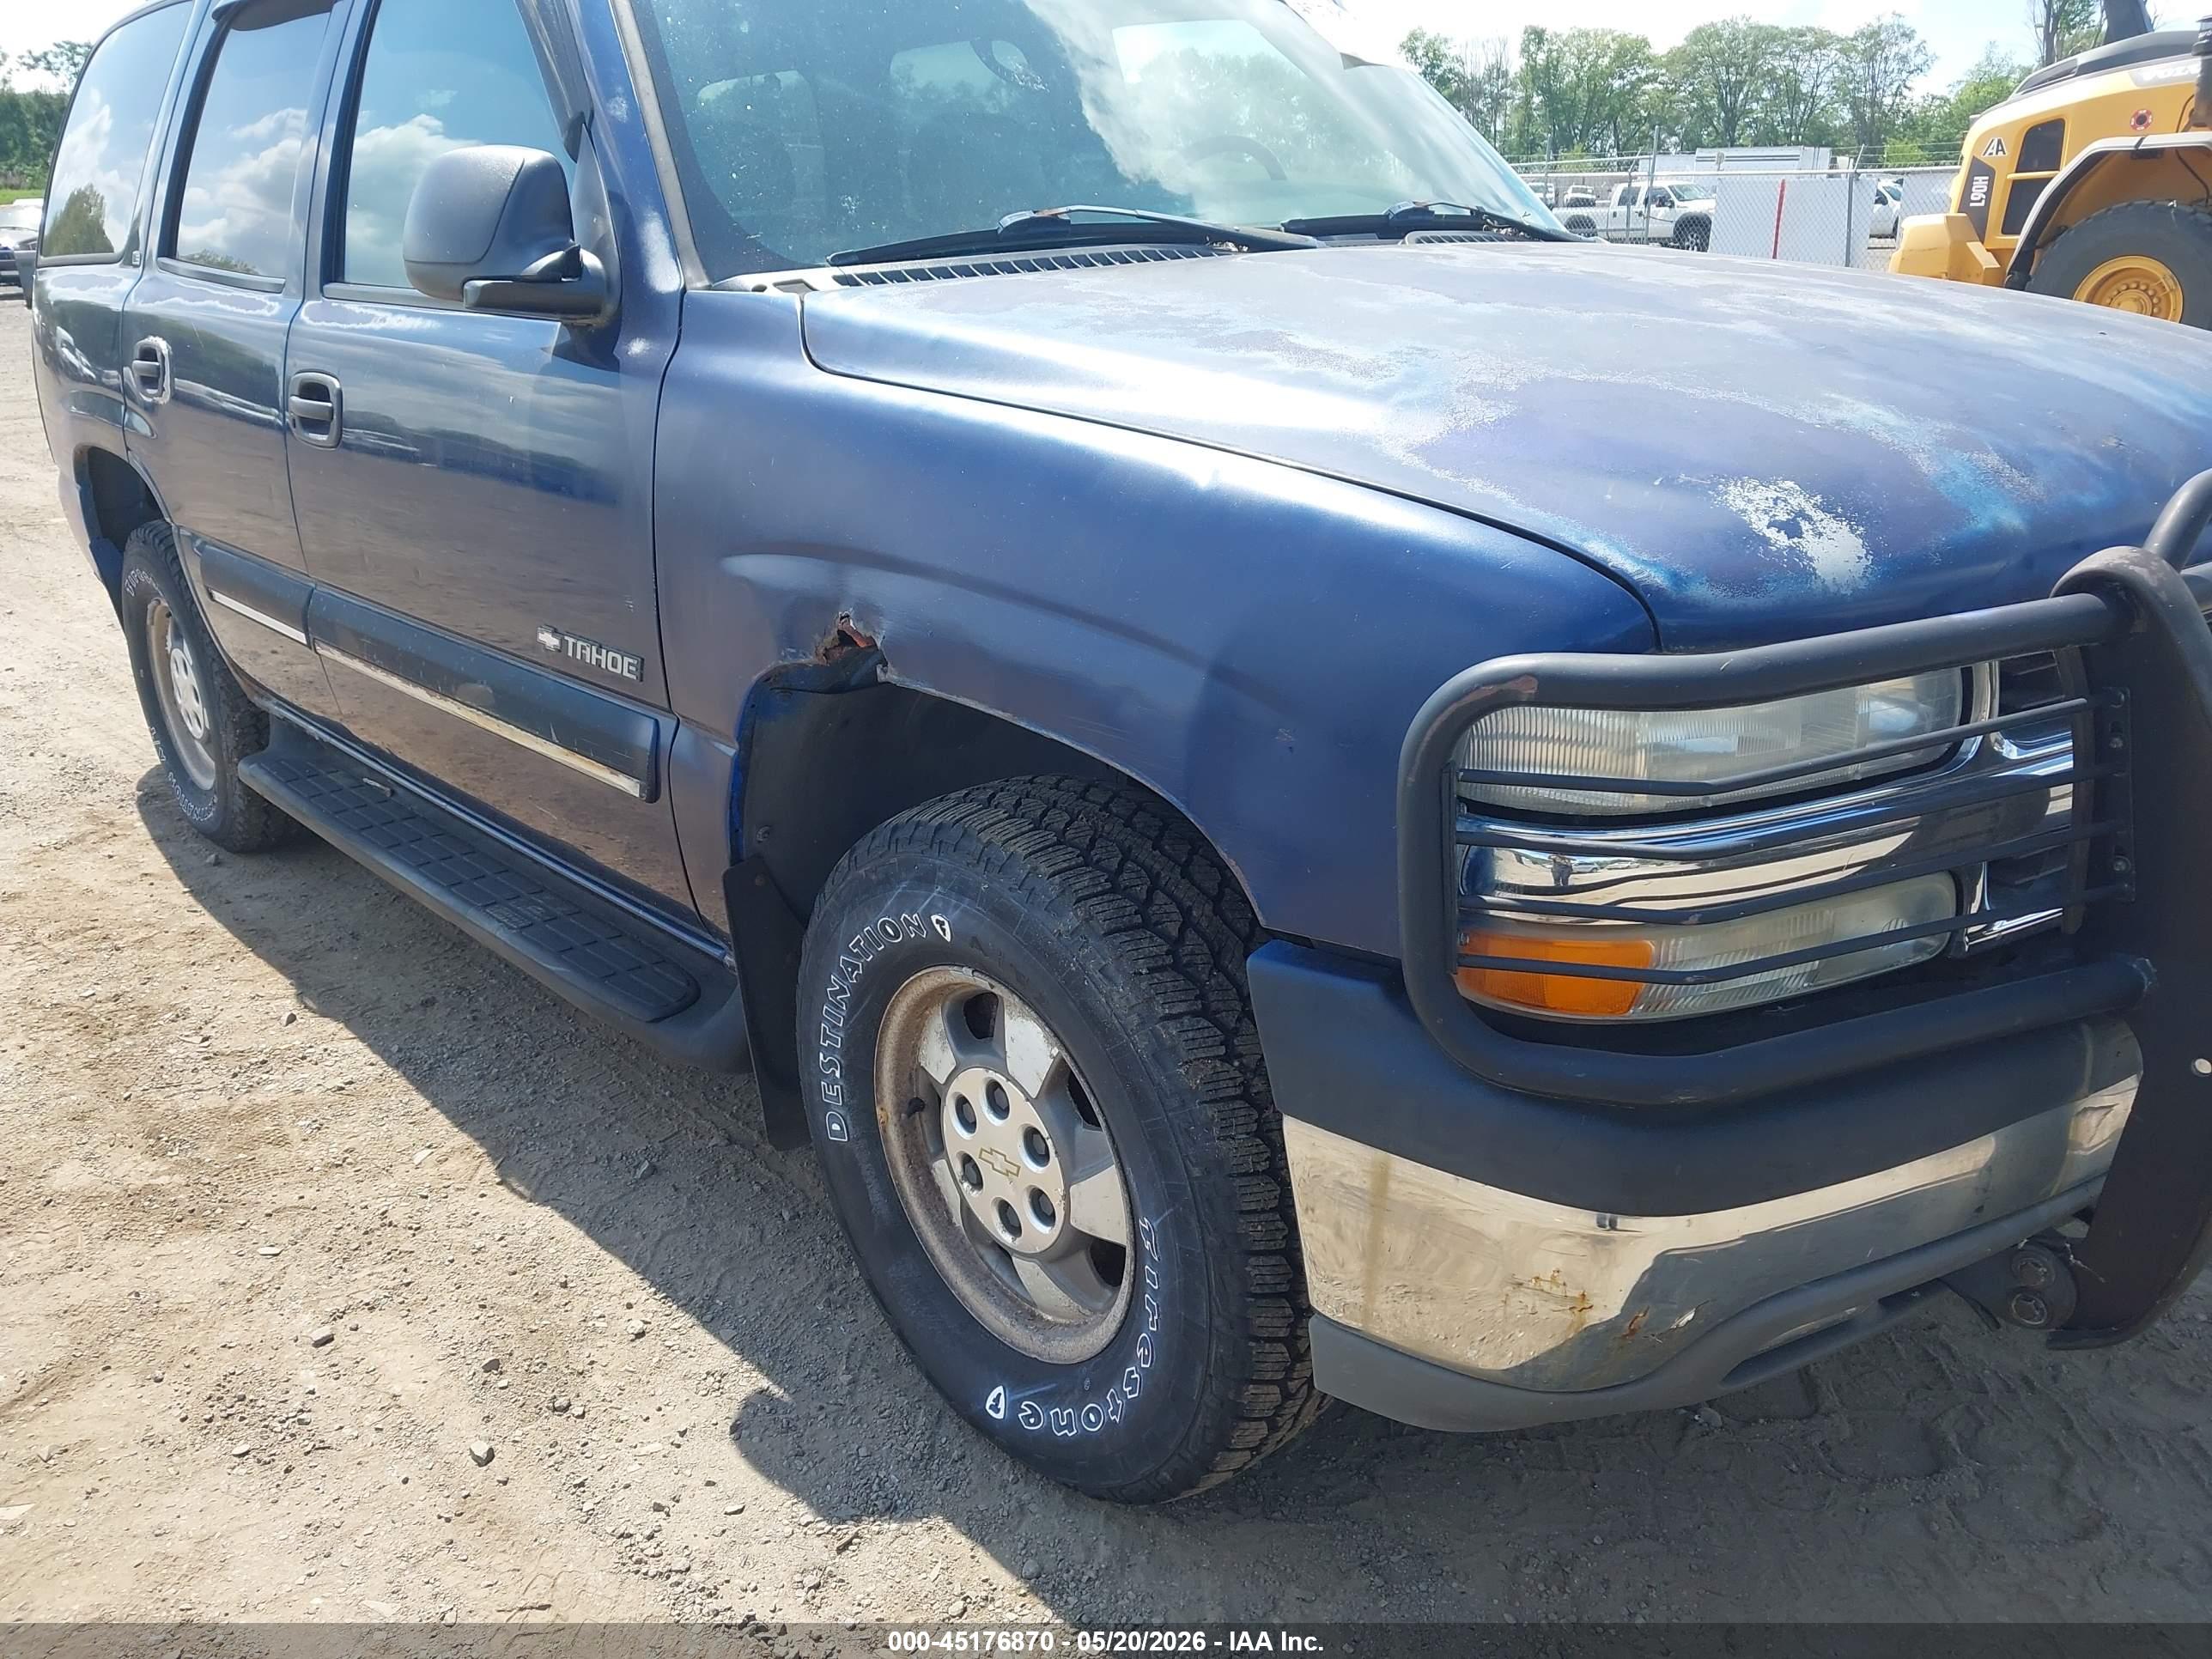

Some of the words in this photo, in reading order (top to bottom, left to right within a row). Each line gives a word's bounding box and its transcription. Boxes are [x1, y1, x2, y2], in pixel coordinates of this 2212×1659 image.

[1970, 175, 1990, 207] L90H
[563, 635, 639, 680] TAHOE
[819, 912, 927, 1142] DESTINATION
[1018, 1216, 1162, 1437] Firestone
